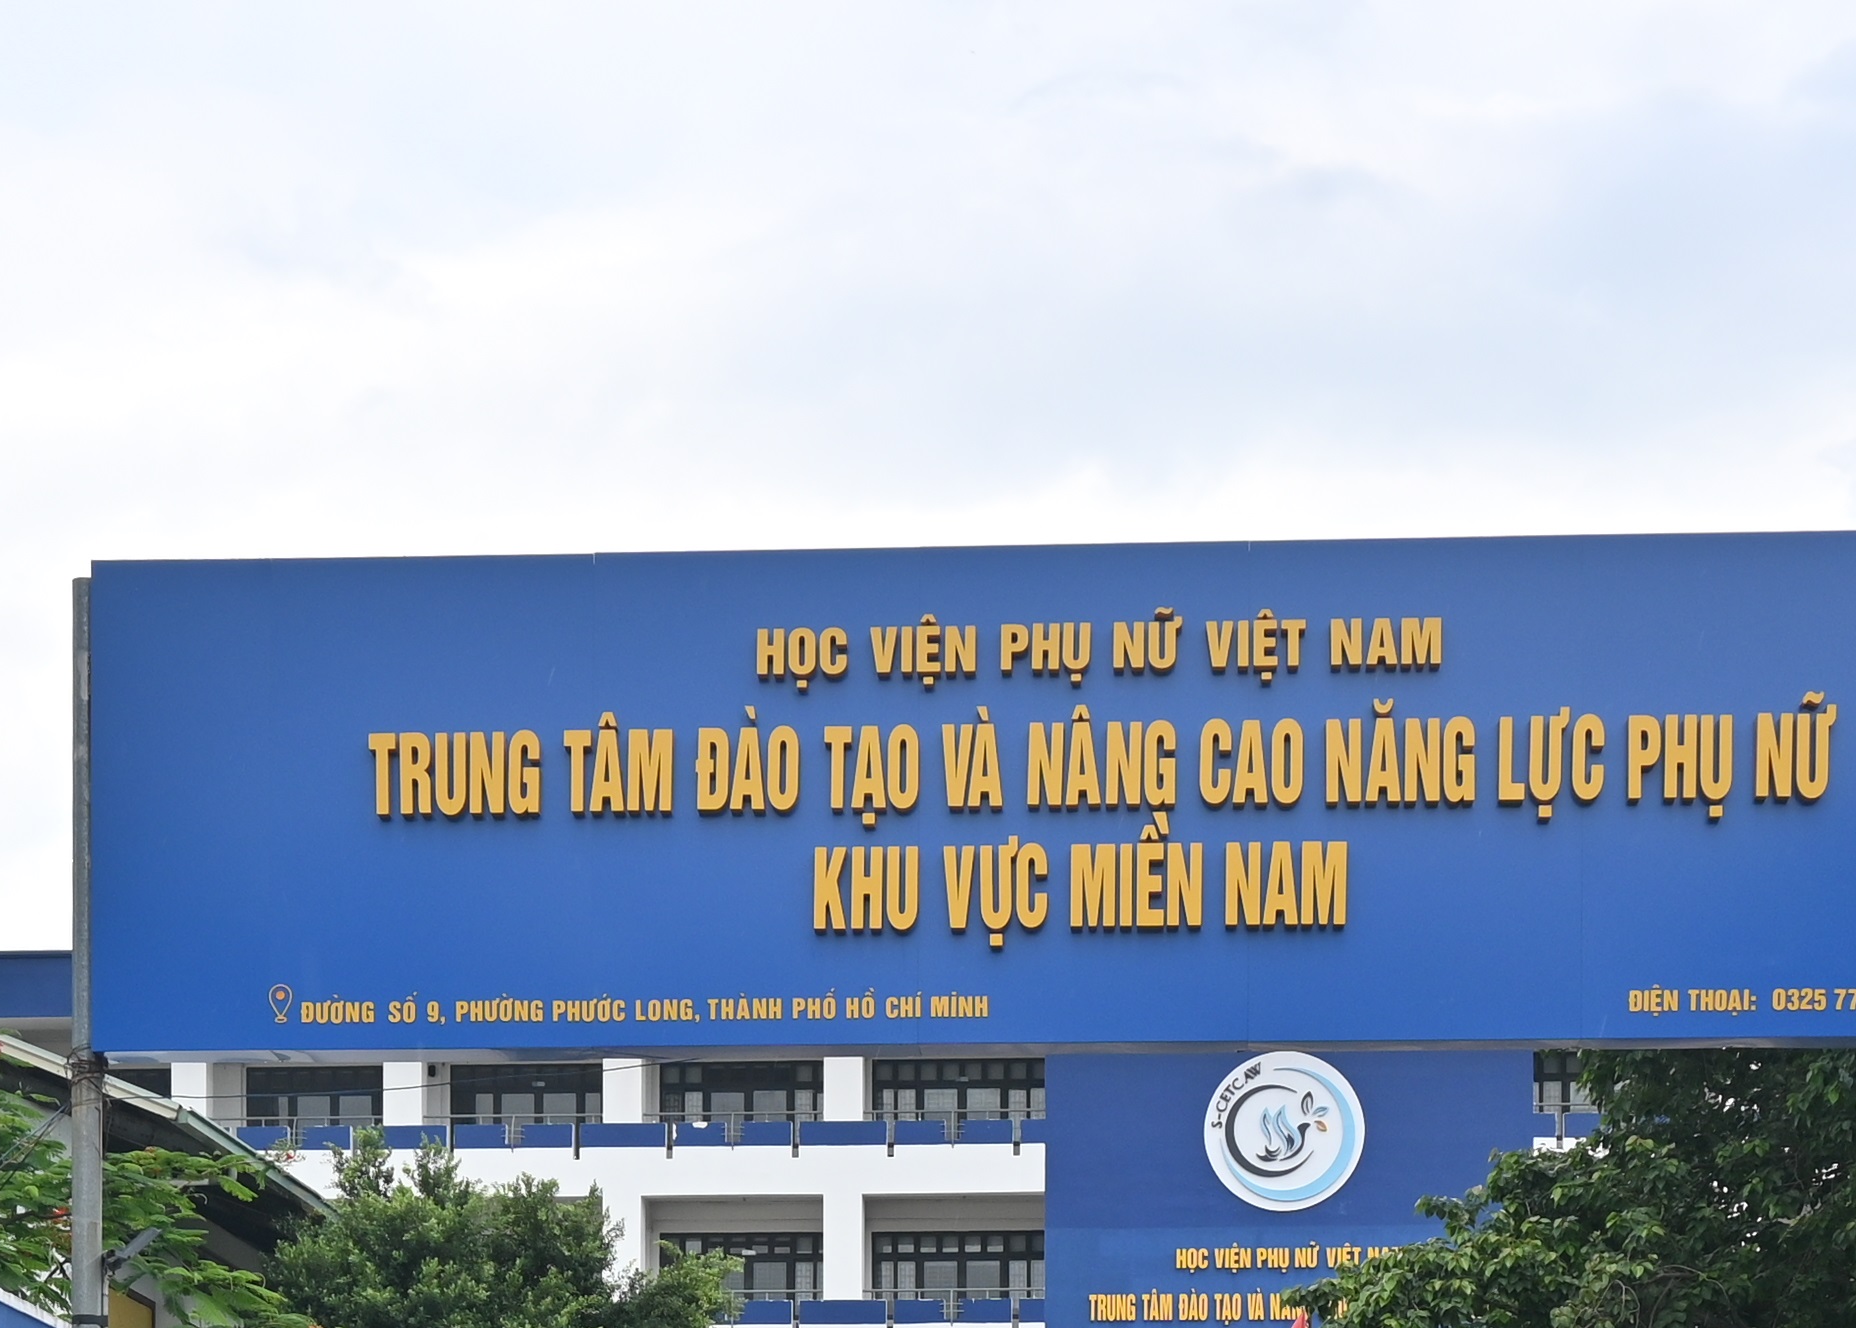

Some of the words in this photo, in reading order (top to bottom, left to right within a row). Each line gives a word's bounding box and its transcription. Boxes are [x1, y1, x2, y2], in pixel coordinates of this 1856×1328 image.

[755, 626, 848, 691] HỌC
[870, 614, 978, 689] VIỆN
[1000, 622, 1092, 688] PHỤ
[1113, 608, 1182, 673] NỮ
[1206, 609, 1306, 686] VIỆT
[1330, 617, 1442, 671] NAM
[368, 730, 541, 819] TRUNG
[564, 711, 673, 818] TÂM
[696, 705, 800, 816] ĐÀO
[824, 725, 919, 828] TẠO
[942, 705, 1003, 812] VÀ
[1027, 704, 1177, 811] NÂNG
[1199, 719, 1303, 809] CAO
[1326, 698, 1476, 808] NĂNG
[1497, 706, 1605, 822] LỰC
[1626, 714, 1734, 820] PHỤ
[1755, 691, 1836, 802] NỮ
[813, 845, 919, 934] KHU
[944, 835, 1048, 948] VỰC
[1070, 811, 1202, 931] MIỀN
[1224, 841, 1348, 931] NAM
[301, 994, 375, 1024] ĐƯỜNG
[388, 991, 418, 1023] SỐ
[427, 1001, 445, 1025] 9,
[456, 993, 543, 1022] PHƯỜNG
[552, 992, 625, 1022] PHƯỚC
[636, 999, 700, 1022] LONG,
[708, 992, 782, 1020] THÀNH
[792, 988, 836, 1019] PHỐ
[846, 987, 875, 1019] HỒ
[886, 991, 922, 1018] CHÍ
[1629, 984, 1678, 1016] ĐIỆN
[1688, 988, 1757, 1016] THOẠI:
[1772, 988, 1827, 1010] 0325
[1176, 1248, 1208, 1274] HỌC
[1215, 1242, 1252, 1274] VIỆN
[1257, 1247, 1290, 1273] PHỤ
[1295, 1241, 1318, 1268] NỮ
[1089, 1294, 1136, 1321] TRUNG
[1142, 1289, 1172, 1321] TÂM
[1179, 1289, 1208, 1320] ĐÀO
[1214, 1294, 1241, 1325] TẠO
[1248, 1288, 1265, 1320] VÀ
